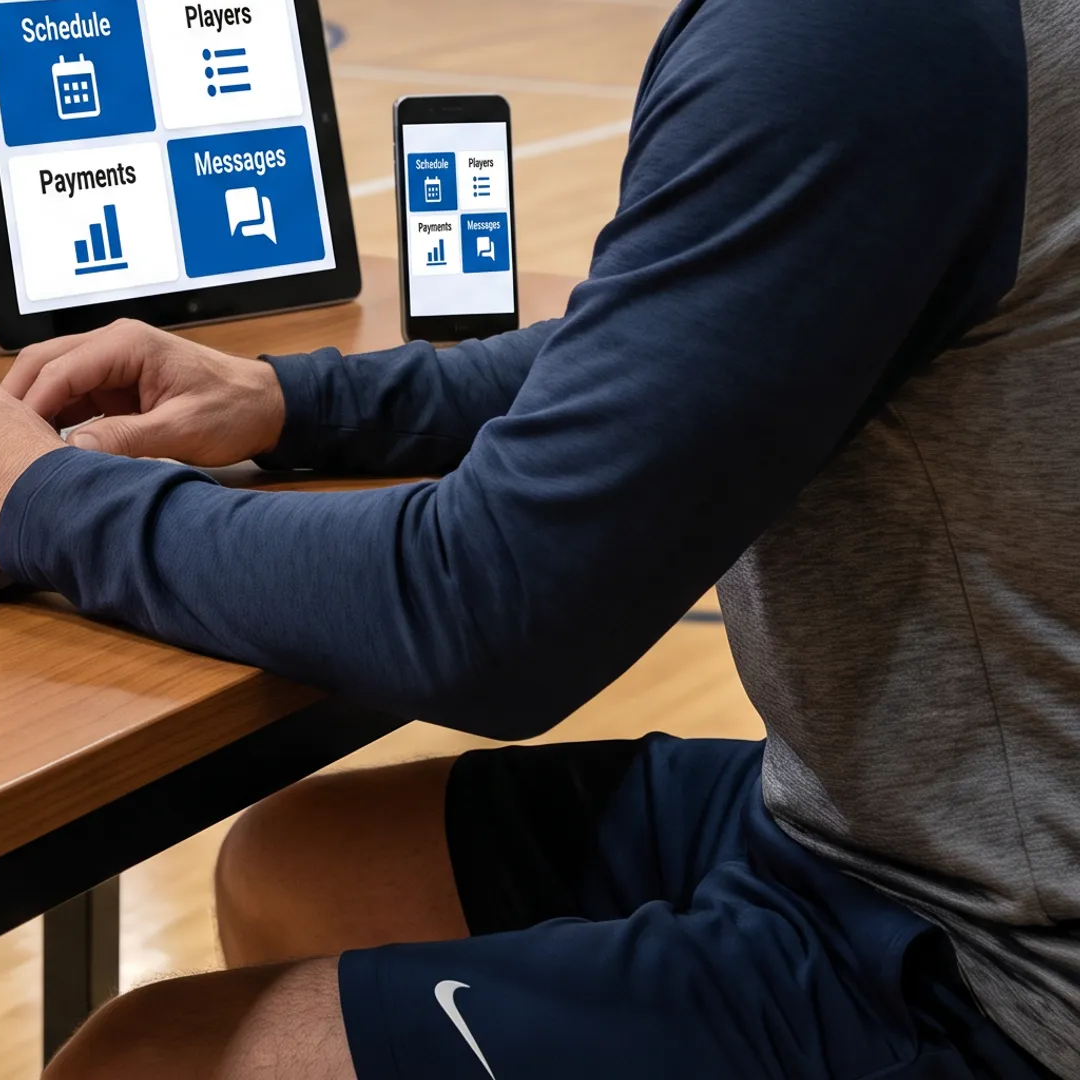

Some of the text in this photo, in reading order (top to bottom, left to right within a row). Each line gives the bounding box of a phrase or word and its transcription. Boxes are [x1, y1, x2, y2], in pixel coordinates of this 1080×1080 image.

[21, 11, 111, 43] Schedule
[185, 3, 252, 33] Players
[194, 148, 287, 177] Messages
[468, 157, 494, 170] Players
[39, 162, 137, 198] Payments
[418, 222, 452, 234] Payments
[467, 220, 501, 232] Messages
